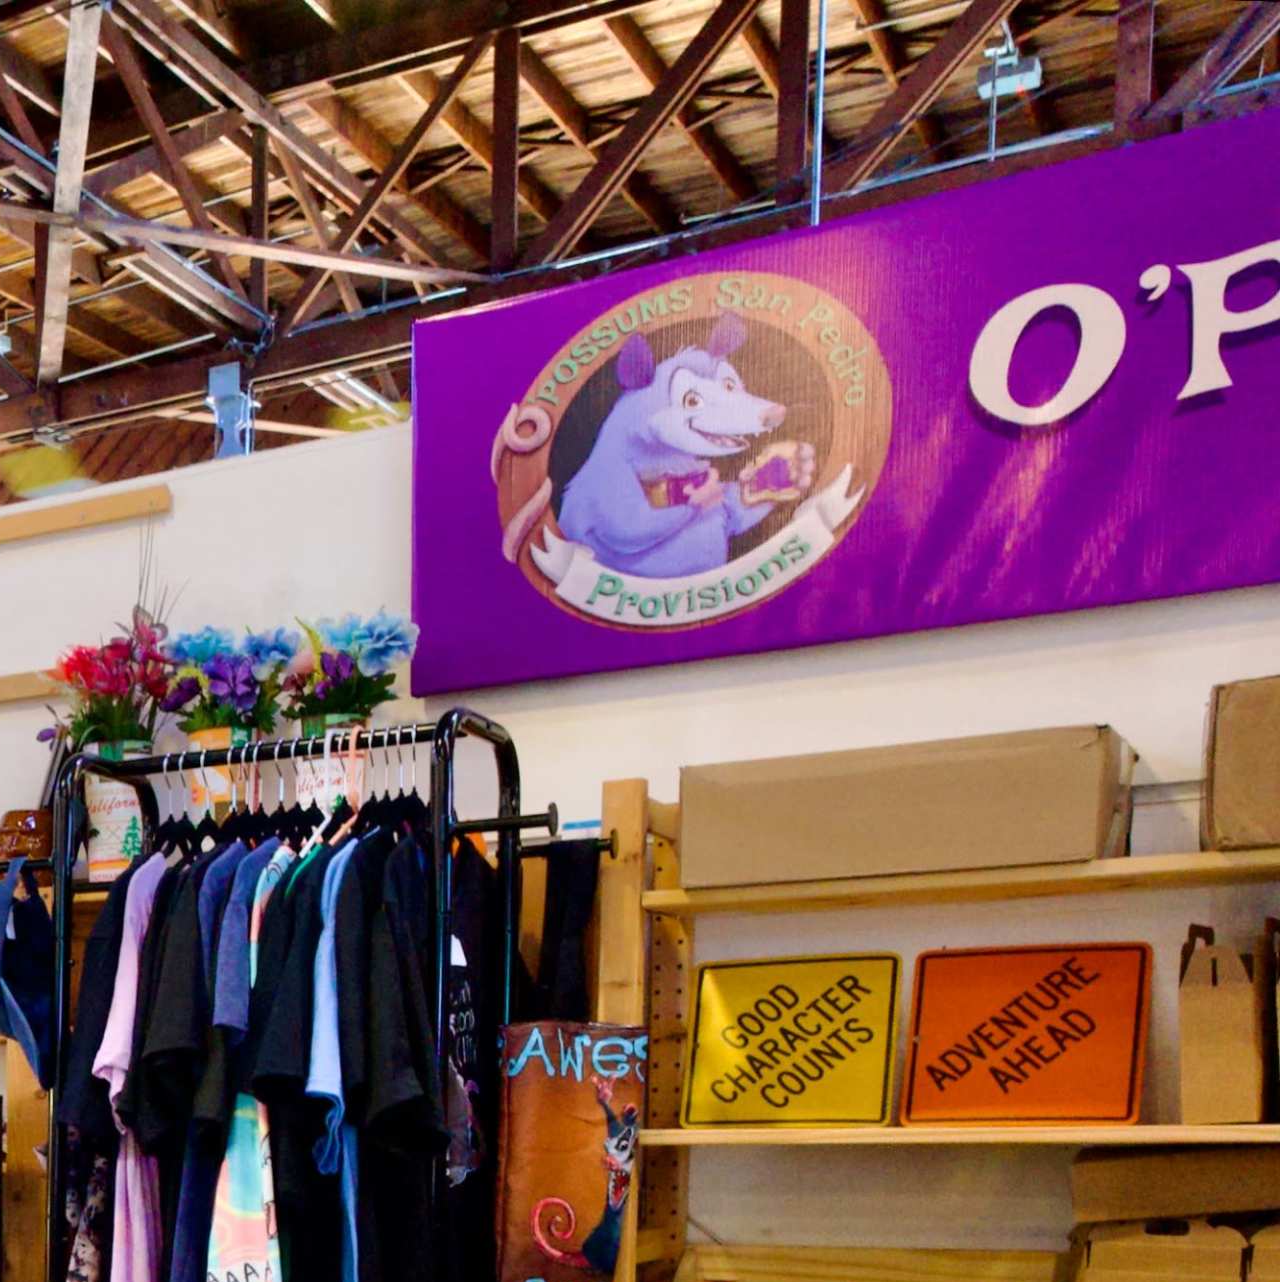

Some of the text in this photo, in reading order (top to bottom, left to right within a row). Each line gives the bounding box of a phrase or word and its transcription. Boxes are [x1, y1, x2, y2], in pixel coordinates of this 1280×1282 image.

[716, 277, 791, 315] San
[799, 301, 869, 407] Pedro
[586, 535, 810, 619] Provisions
[709, 973, 873, 1105] CHARACTER
[721, 982, 801, 1051] GOOD
[759, 1016, 875, 1109] COUNTS
[924, 956, 1102, 1093] ADVENTURE
[986, 1006, 1099, 1095] AHEAD
